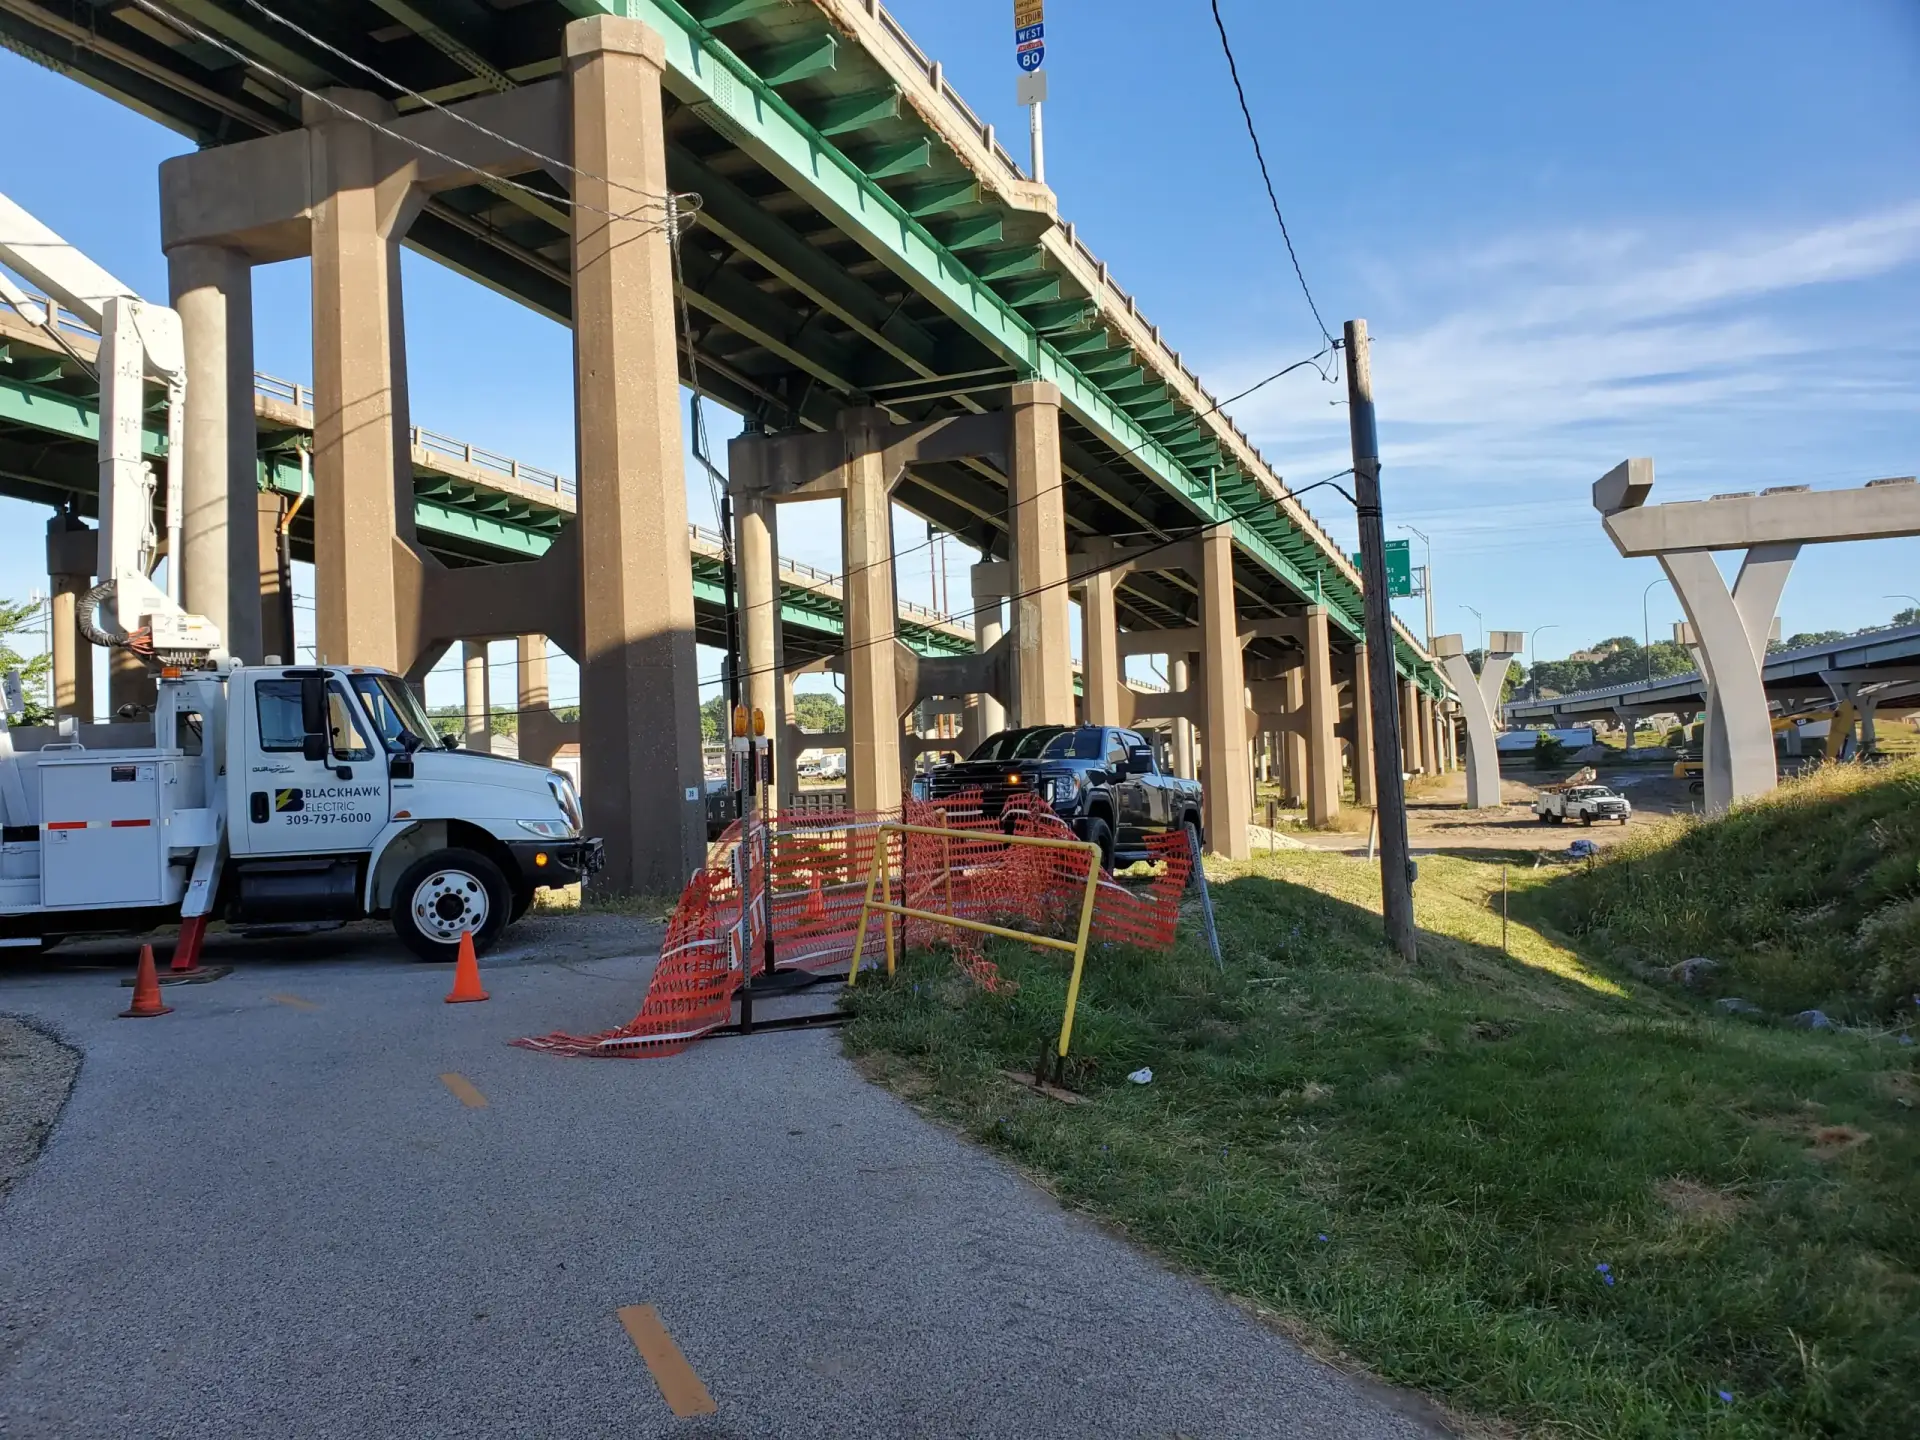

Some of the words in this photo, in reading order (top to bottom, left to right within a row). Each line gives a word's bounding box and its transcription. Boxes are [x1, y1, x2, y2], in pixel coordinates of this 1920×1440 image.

[1018, 27, 1041, 41] WEST
[1023, 52, 1040, 67] 80
[305, 786, 381, 799] BLACKHAWK
[305, 801, 355, 812] ELECTRIC
[286, 812, 372, 825] 309-797-6000
